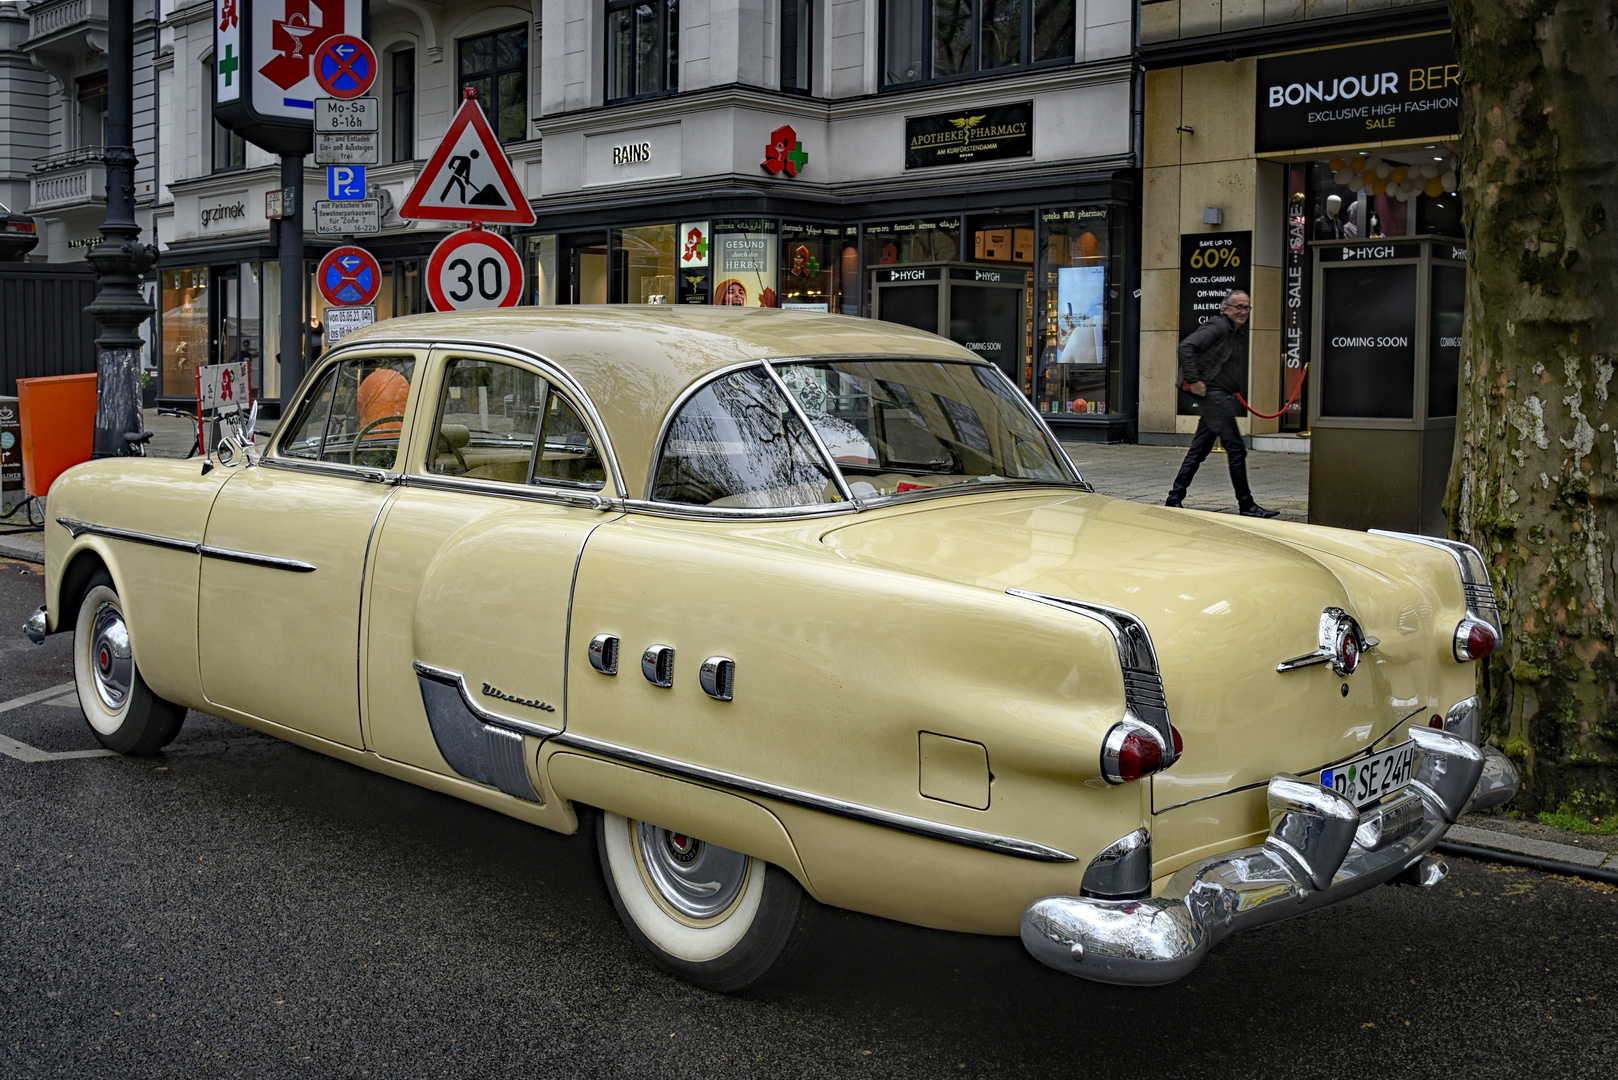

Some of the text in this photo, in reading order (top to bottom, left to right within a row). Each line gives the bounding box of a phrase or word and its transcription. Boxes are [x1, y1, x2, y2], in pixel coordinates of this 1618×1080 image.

[1269, 72, 1398, 107] BONJOUR
[328, 102, 366, 113] Mo-Sa
[1308, 97, 1458, 123] EXCLUSIVE HIGH FASHION
[332, 117, 362, 127] 8-16h
[1366, 117, 1396, 130] SALE
[911, 122, 1027, 145] APOTHEKE PHARMACY
[613, 142, 651, 165] RAINS
[946, 143, 998, 154] KURFÜRSTENDAMM
[333, 167, 354, 196] P
[201, 201, 245, 226] grzimek
[1078, 210, 1107, 219] pharmacy
[725, 240, 765, 249] GESUND
[1190, 247, 1241, 269] 60%
[1356, 246, 1395, 259] HYGH
[726, 261, 765, 269] HERBST
[448, 257, 502, 302] 30
[900, 270, 925, 280] HYGH
[982, 272, 1000, 282] HYGH
[1288, 267, 1302, 308] SALE
[1193, 303, 1224, 311] BALENCI
[330, 327, 338, 339] bis
[965, 342, 1002, 350] COMING SOON
[1287, 327, 1301, 369] SALE
[1332, 337, 1408, 347] COMING SOON
[482, 682, 555, 712] Ultramatic
[1357, 759, 1380, 801] SE
[1381, 747, 1414, 792] 24H
